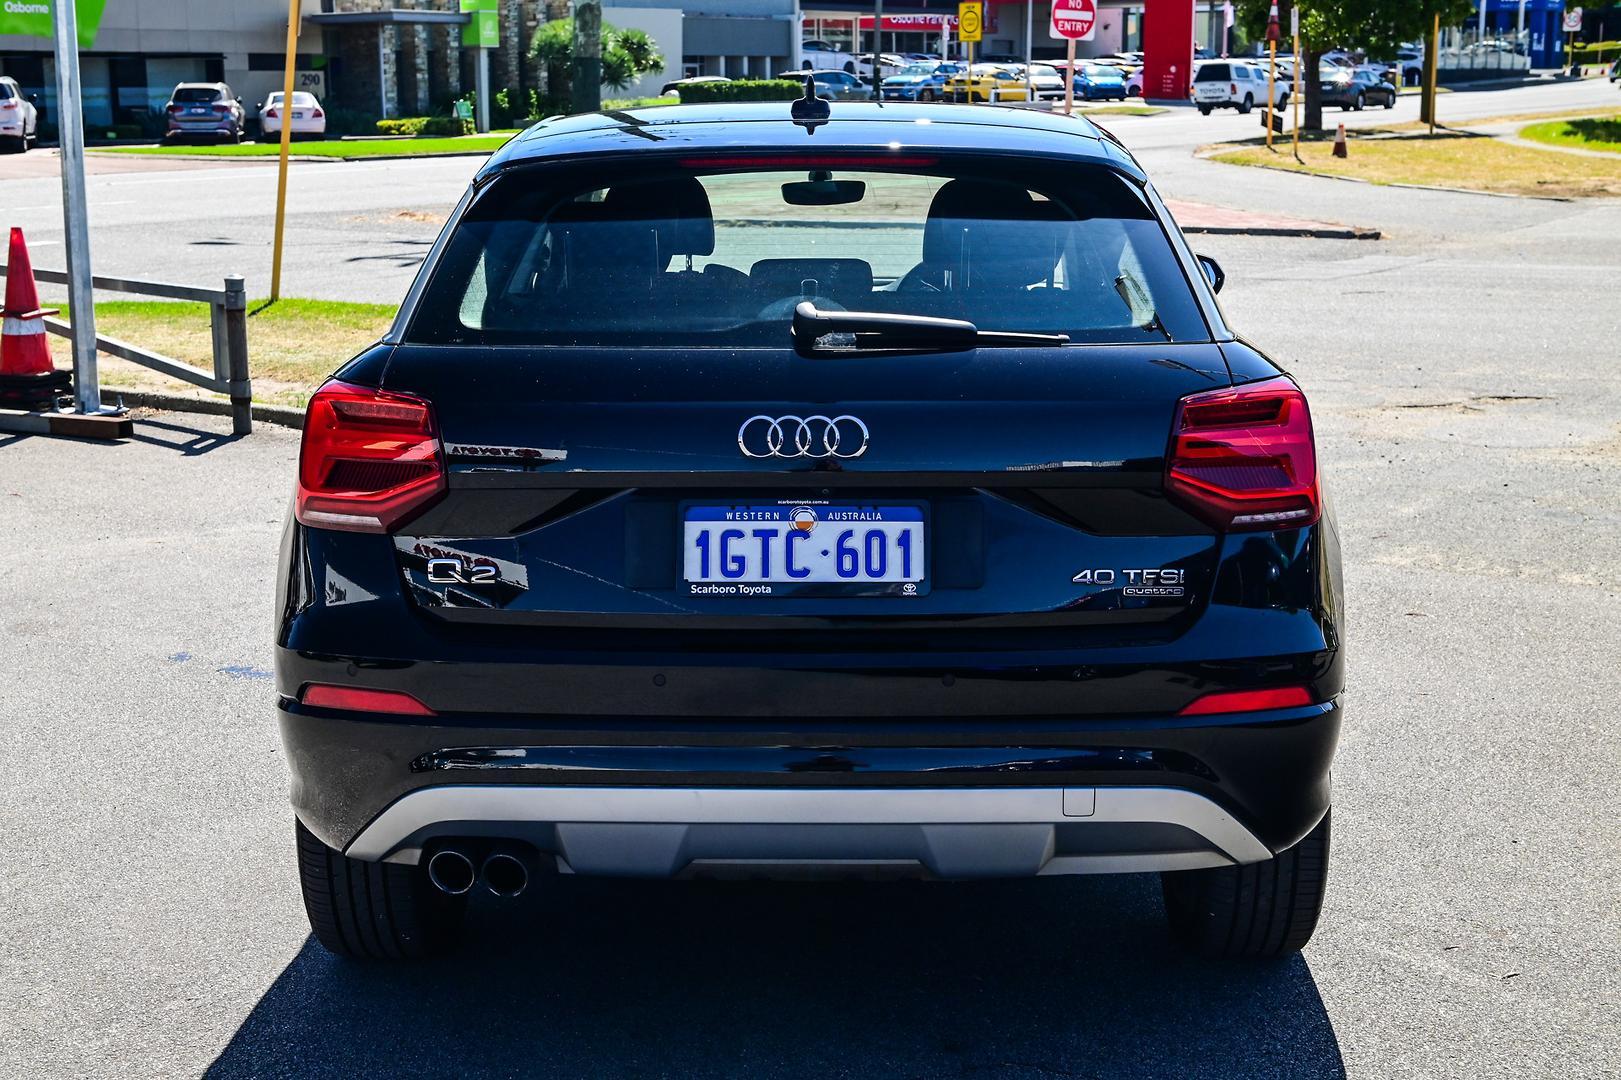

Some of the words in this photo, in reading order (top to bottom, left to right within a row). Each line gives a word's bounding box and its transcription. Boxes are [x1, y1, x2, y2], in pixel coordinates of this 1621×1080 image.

[4, 1, 49, 14] Osborne
[1068, 0, 1082, 9] NO
[1058, 21, 1089, 32] ENTRY
[301, 73, 320, 86] 290
[1200, 87, 1225, 95] TOYOTA
[726, 512, 780, 520] WESTERN
[827, 512, 882, 520] AUSTRALIA
[427, 559, 496, 584] Q2
[1072, 569, 1115, 584] 40
[1122, 569, 1185, 584] TFSI
[690, 584, 736, 594] Scarboro
[738, 584, 772, 595] Toyota
[1125, 587, 1183, 596] quattro
